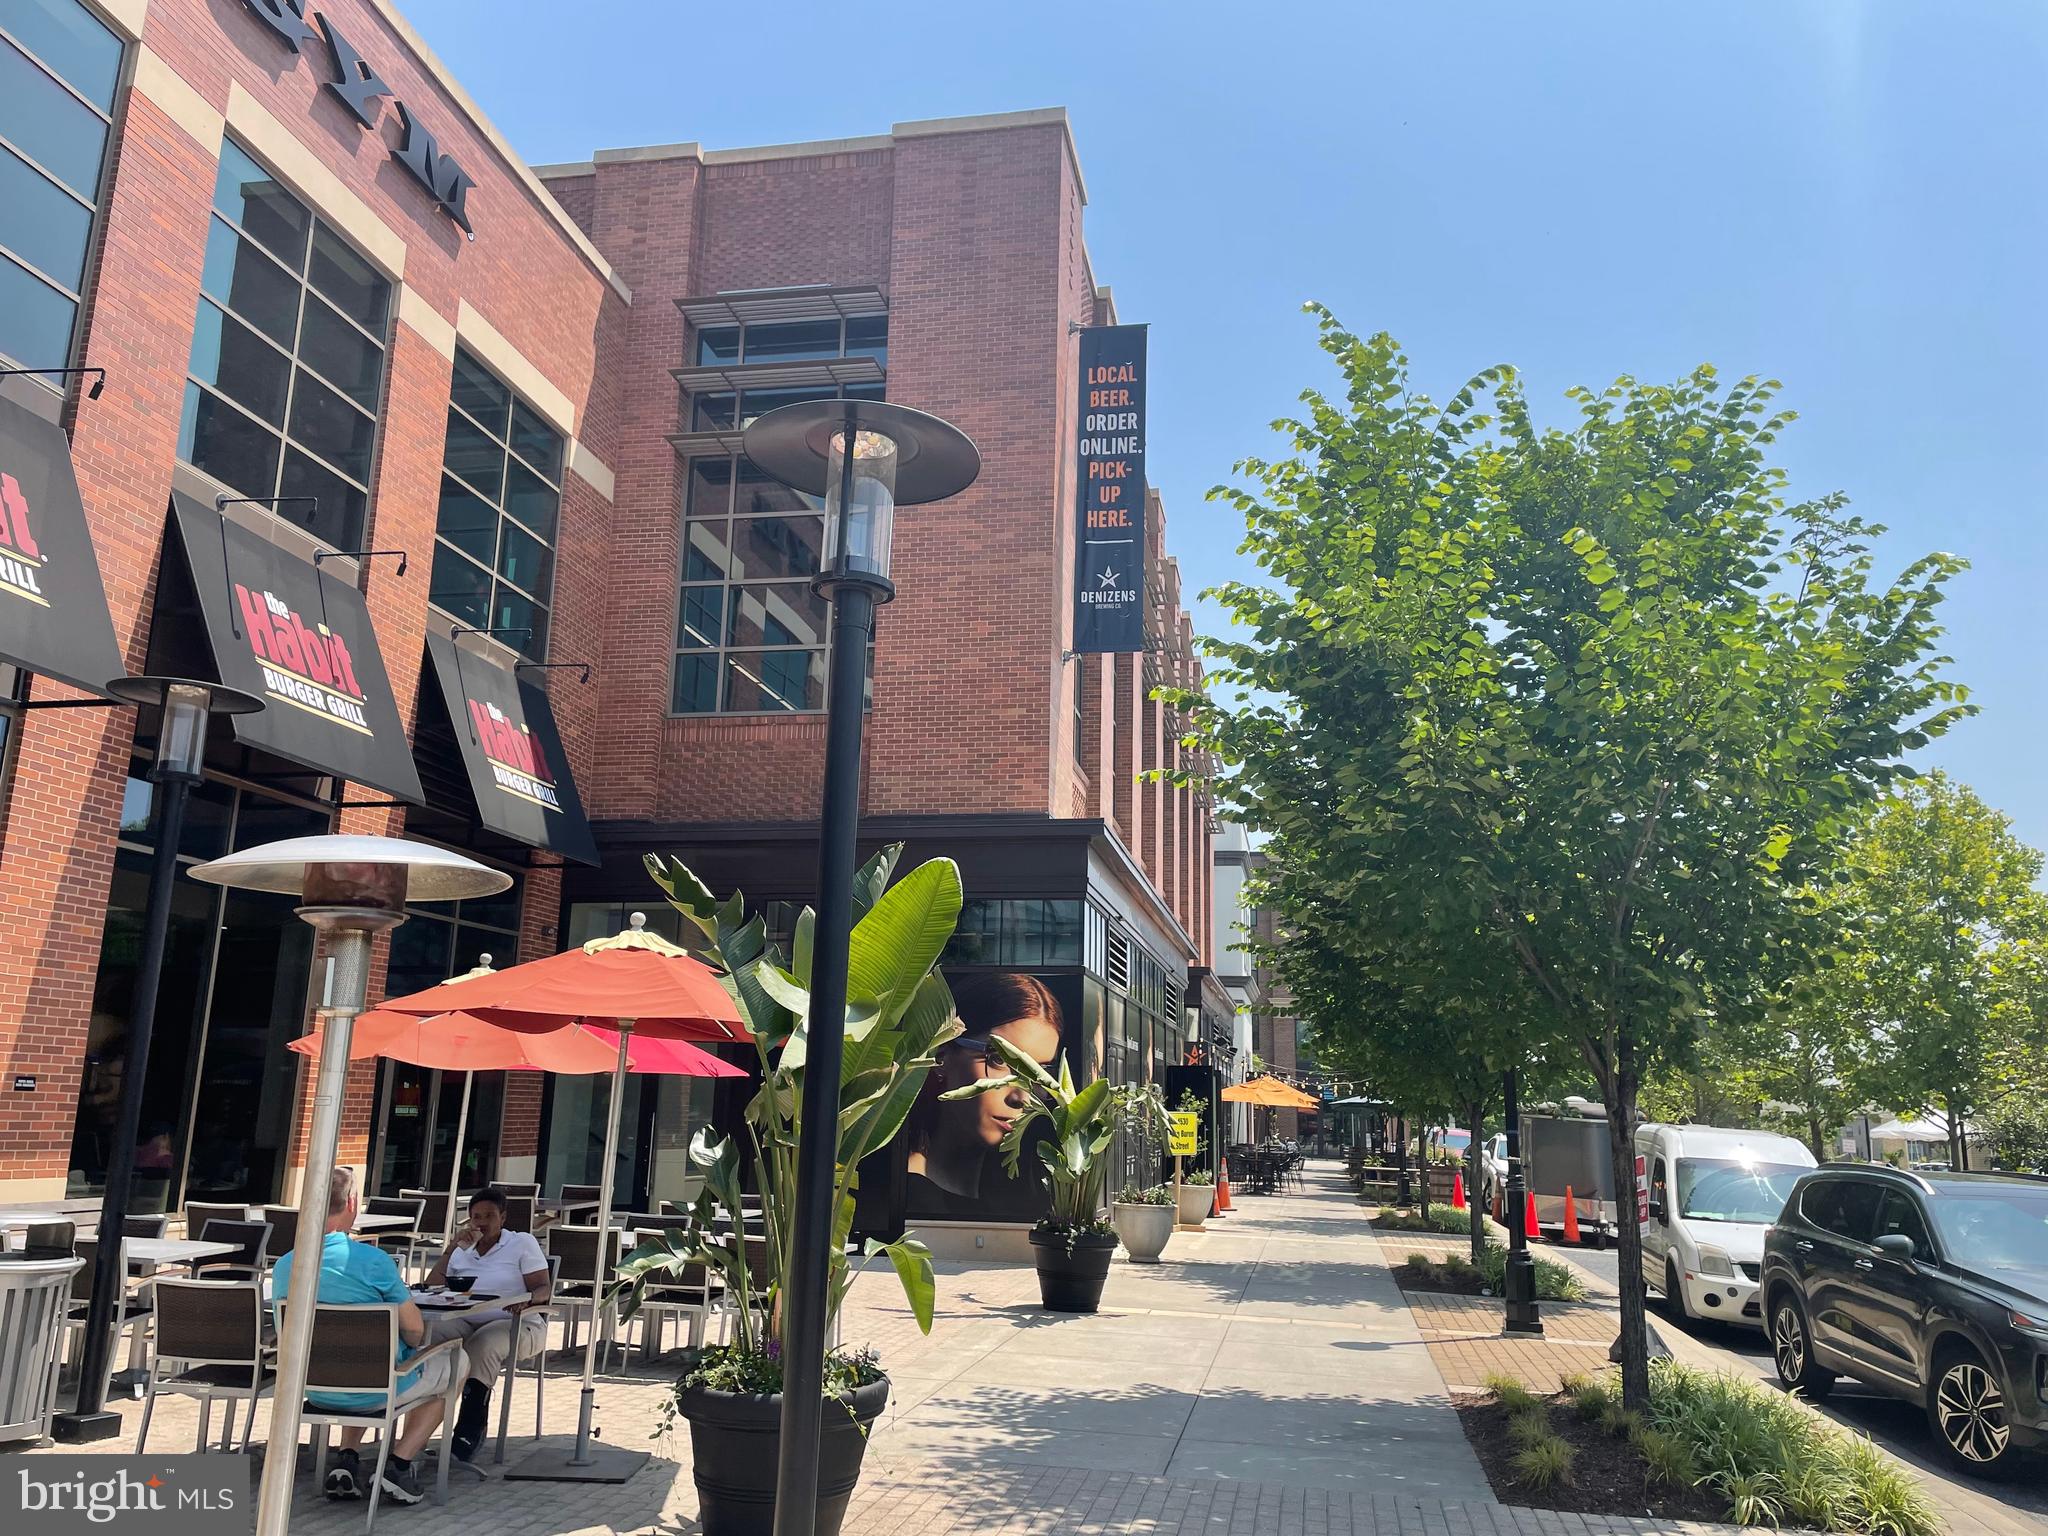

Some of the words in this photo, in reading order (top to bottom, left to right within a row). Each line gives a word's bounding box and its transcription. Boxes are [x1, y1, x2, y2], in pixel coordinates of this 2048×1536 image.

[1088, 365, 1138, 385] LOCAL
[1090, 389, 1135, 408] BEER.
[1086, 412, 1138, 432] ORDER
[1080, 436, 1143, 456] ONLINE.
[1089, 461, 1132, 479] PICK-
[1100, 485, 1121, 503] UP
[1087, 509, 1133, 528] HERE.
[263, 590, 291, 621] the
[1080, 590, 1136, 603] DENIZENS
[235, 583, 363, 699] Habit
[262, 667, 327, 711] BURGER
[327, 695, 368, 727] GRILL
[486, 701, 505, 724] the
[468, 698, 554, 785] Habit
[491, 764, 534, 796] BURGER
[532, 782, 559, 806] GRILL
